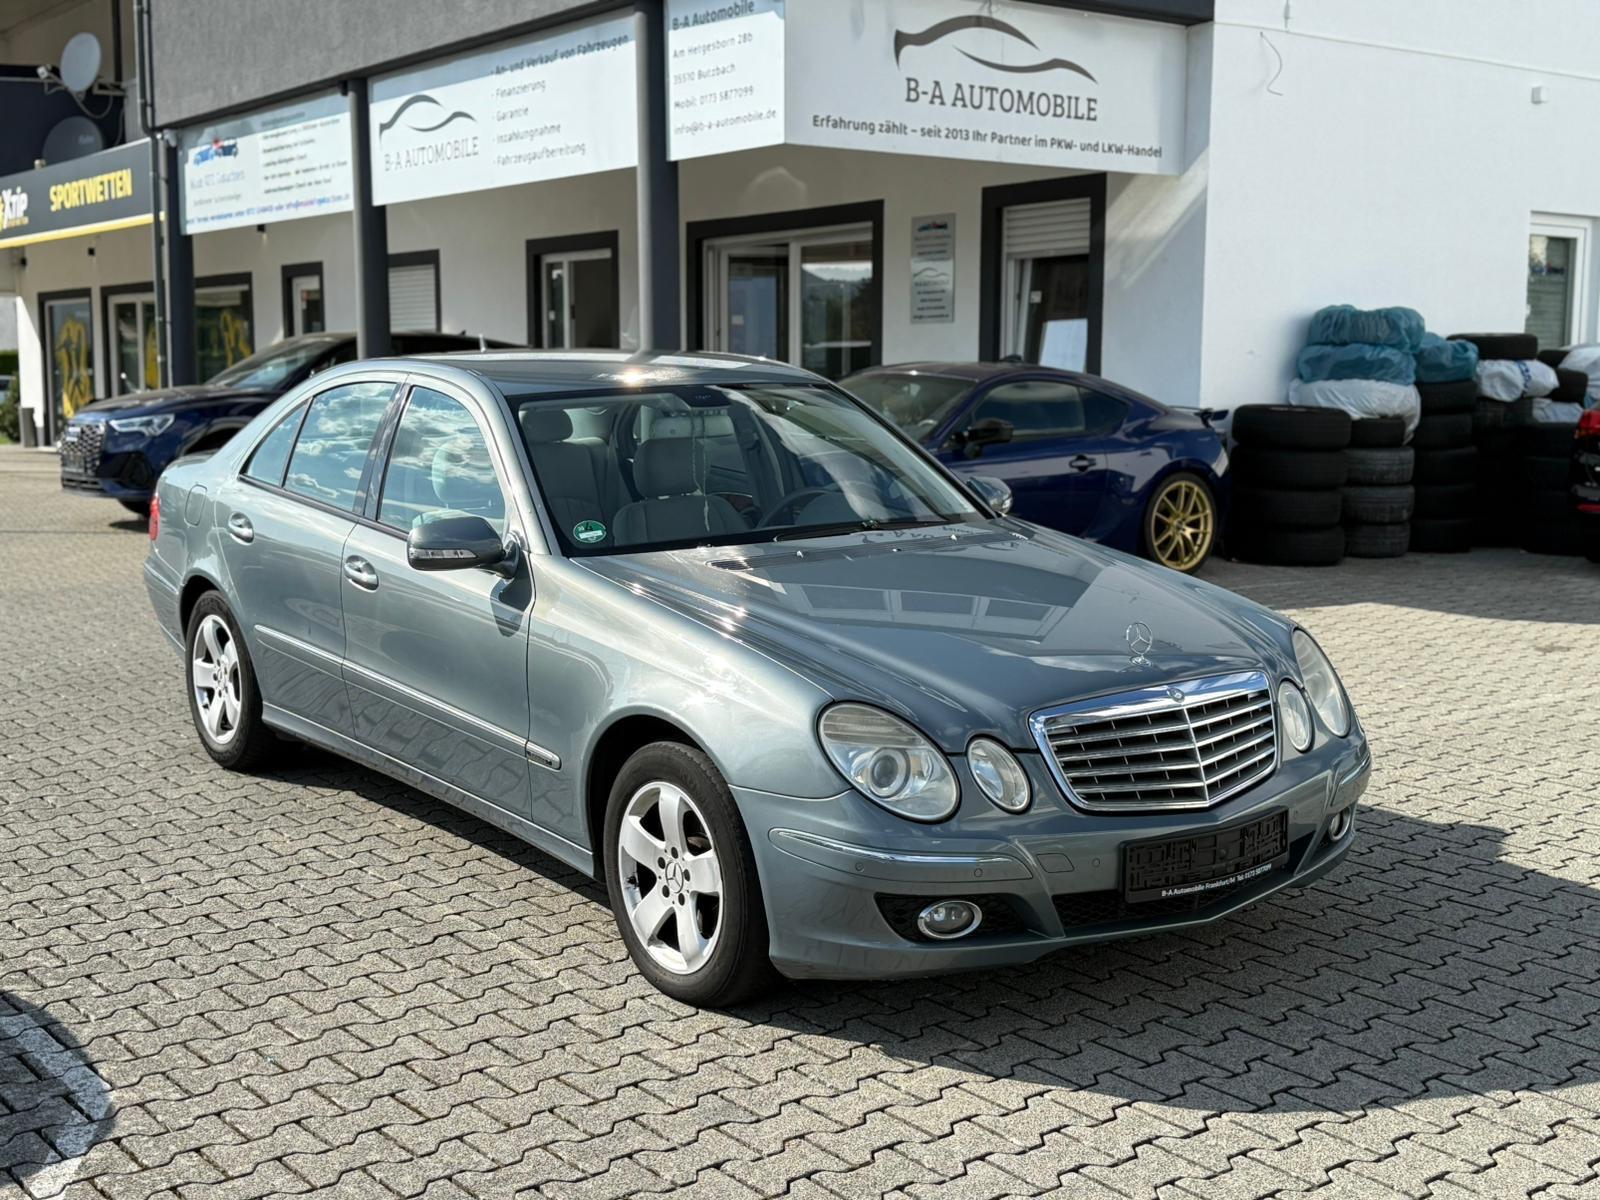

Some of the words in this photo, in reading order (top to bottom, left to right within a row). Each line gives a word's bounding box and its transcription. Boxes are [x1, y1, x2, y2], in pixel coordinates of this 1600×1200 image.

[672, 15, 690, 30] B-A
[692, 0, 755, 25] Automobile
[525, 49, 558, 68] Verkauf
[559, 47, 576, 60] von
[576, 34, 629, 56] Fahrzeugen
[673, 50, 685, 58] Am
[697, 63, 736, 80] Butzbach
[496, 79, 546, 98] Finanzierung
[905, 77, 946, 106] B-A
[951, 83, 1097, 121] AUTOMOBILE
[496, 105, 529, 122] Garantie
[812, 114, 876, 135] Erfahrung
[878, 120, 908, 136] zählt
[920, 125, 942, 139] seit
[944, 127, 970, 141] 2013
[972, 130, 988, 143] Ihr
[991, 131, 1032, 147] Partner
[1034, 134, 1048, 148] im
[1050, 137, 1078, 151] PKW-
[1080, 141, 1099, 153] und
[1101, 142, 1162, 158] LKW-Handel
[384, 151, 402, 172] B-A
[405, 136, 480, 169] AUTOMOBILE
[497, 142, 587, 166] Fahrzeugaufbereitung
[49, 168, 133, 212] SPORTWETTEN
[1161, 888, 1174, 897] B-A
[1173, 884, 1205, 896] Automobile
